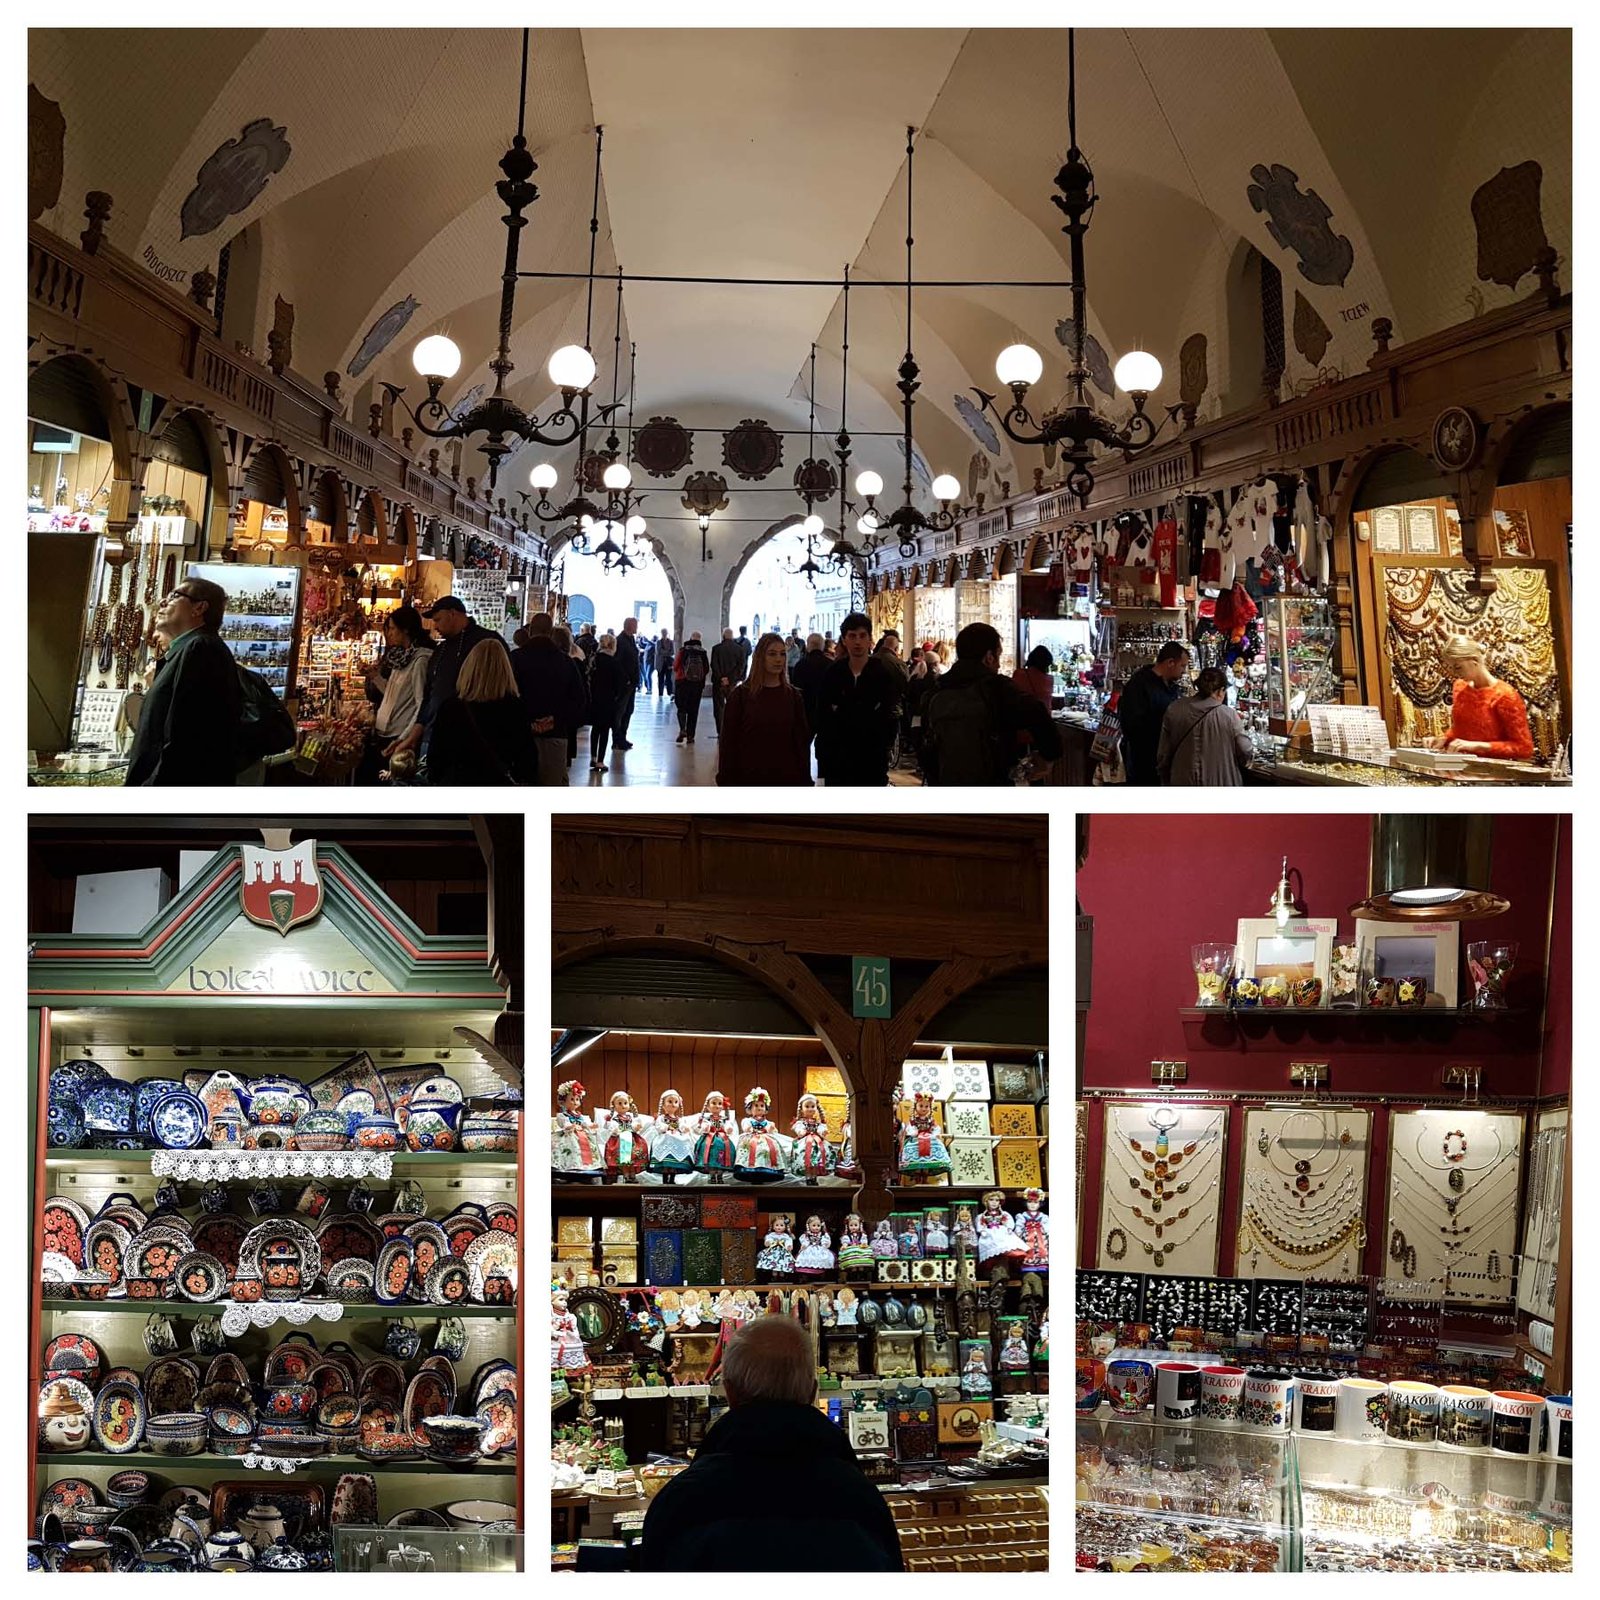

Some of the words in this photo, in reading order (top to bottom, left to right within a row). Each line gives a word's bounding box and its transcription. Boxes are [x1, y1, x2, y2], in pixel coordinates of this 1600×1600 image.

[143, 245, 187, 282] BYDGOSZCZ
[1339, 302, 1369, 322] TCZEW
[856, 965, 887, 1007] 45
[1390, 1391, 1437, 1406] KRAKÓW
